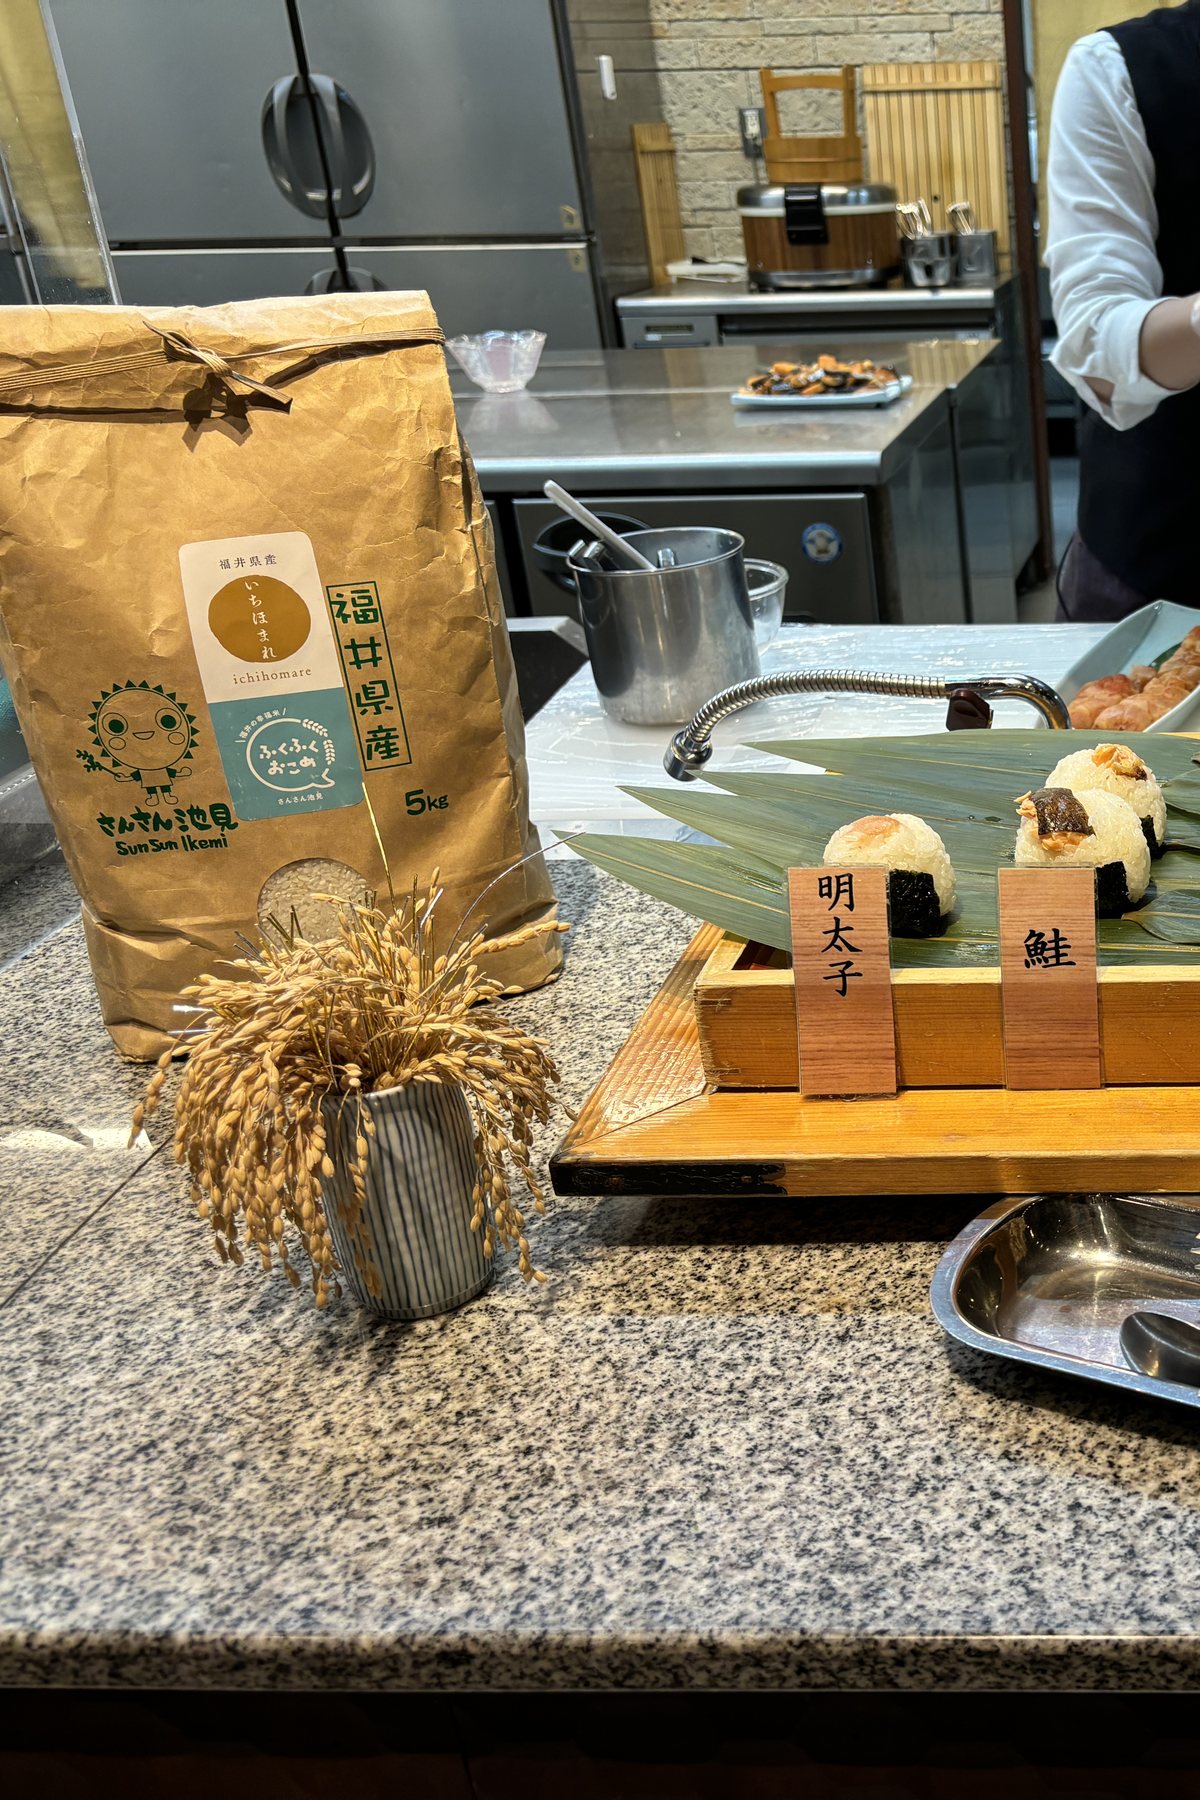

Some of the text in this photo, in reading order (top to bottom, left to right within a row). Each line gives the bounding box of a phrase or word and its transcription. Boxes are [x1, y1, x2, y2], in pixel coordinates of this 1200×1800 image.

[219, 554, 278, 570] 福井県産
[244, 580, 277, 660] いちほまれ
[233, 667, 312, 685] ichihomare
[331, 588, 401, 762] 福井県産
[259, 738, 319, 760] ふくふく
[267, 756, 317, 775] おこめ
[277, 792, 324, 806] さんさん池見
[404, 789, 450, 816] 5kg
[96, 803, 239, 838] さんさん池見
[182, 833, 229, 851] Ikemi
[818, 872, 863, 998] 明太子
[1023, 928, 1077, 970] 鮭
